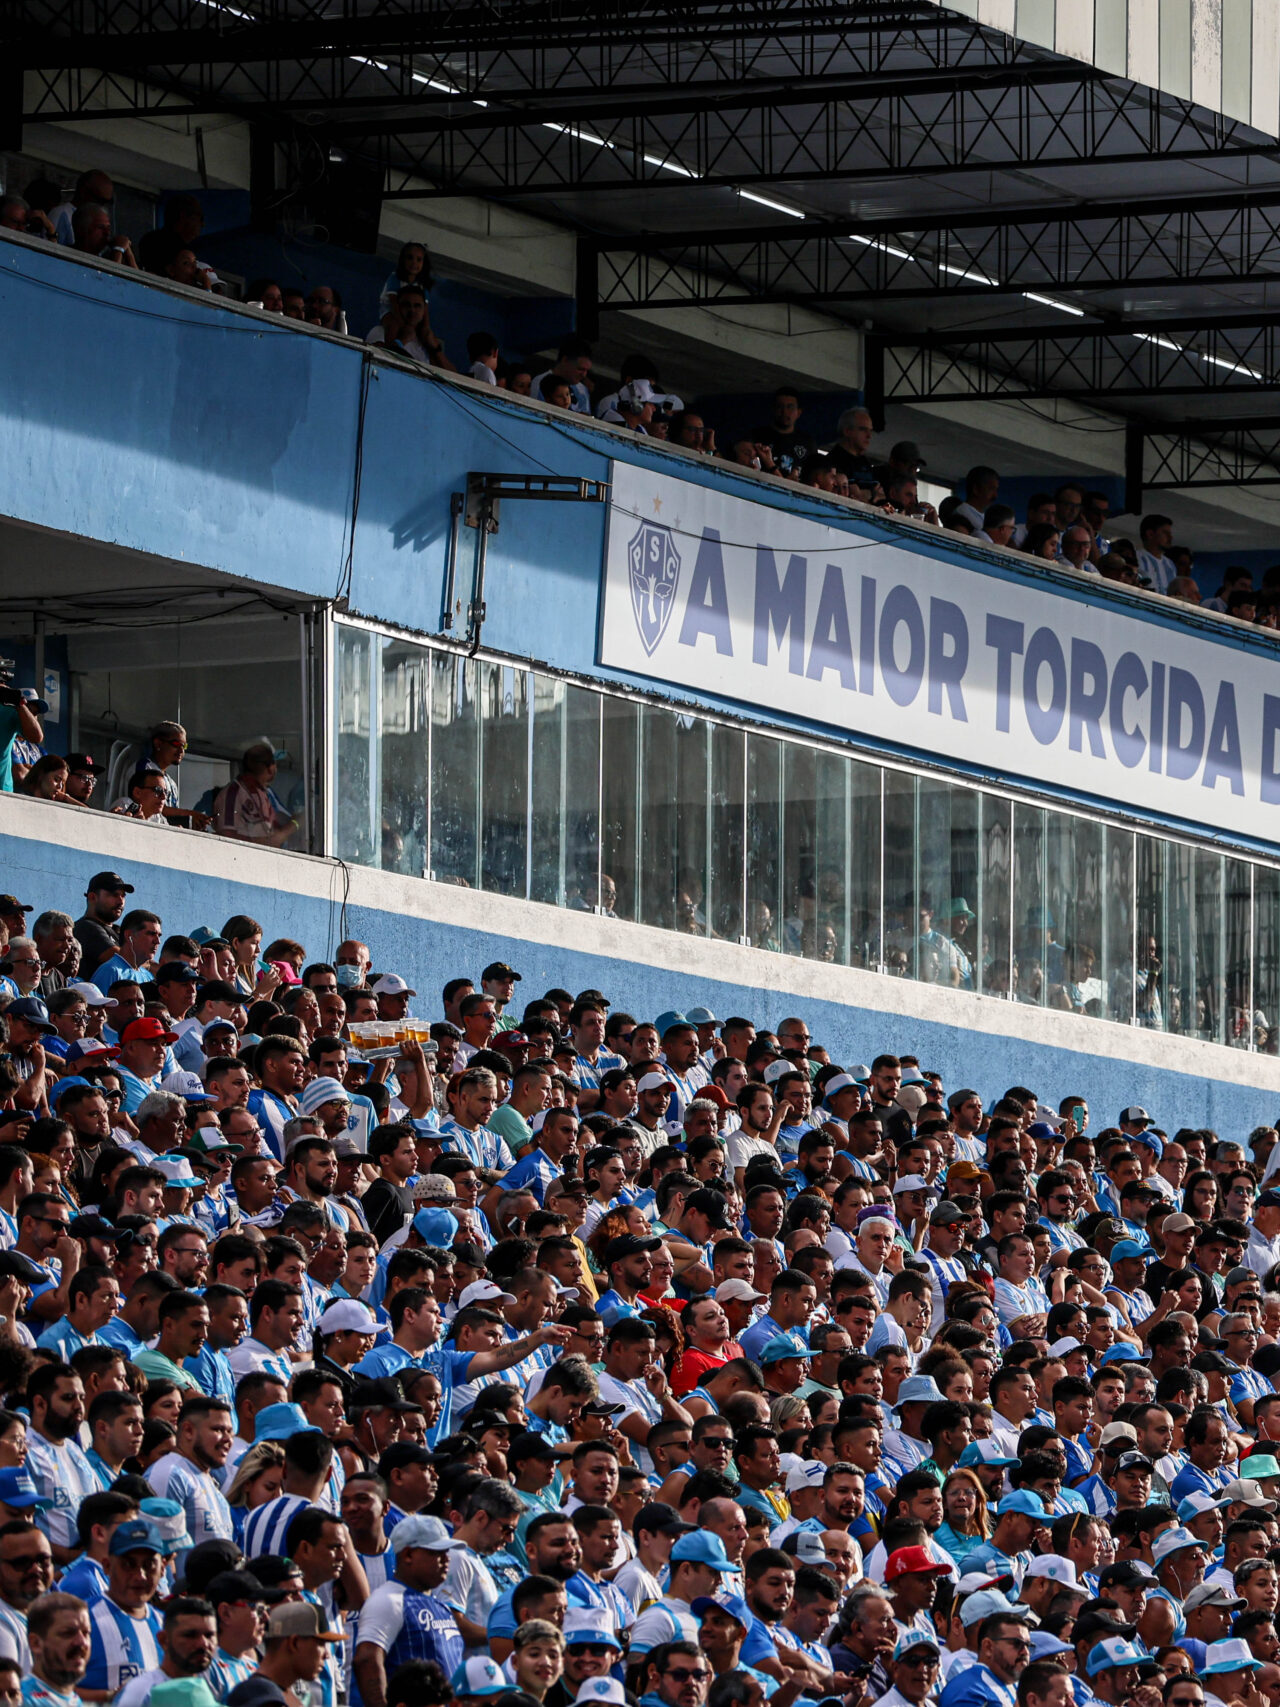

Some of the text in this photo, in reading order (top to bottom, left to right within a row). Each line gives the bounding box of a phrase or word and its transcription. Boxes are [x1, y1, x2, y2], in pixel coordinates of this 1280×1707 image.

[678, 526, 734, 657] A
[752, 543, 970, 723] MAIOR
[985, 612, 1246, 797] TORCIDA
